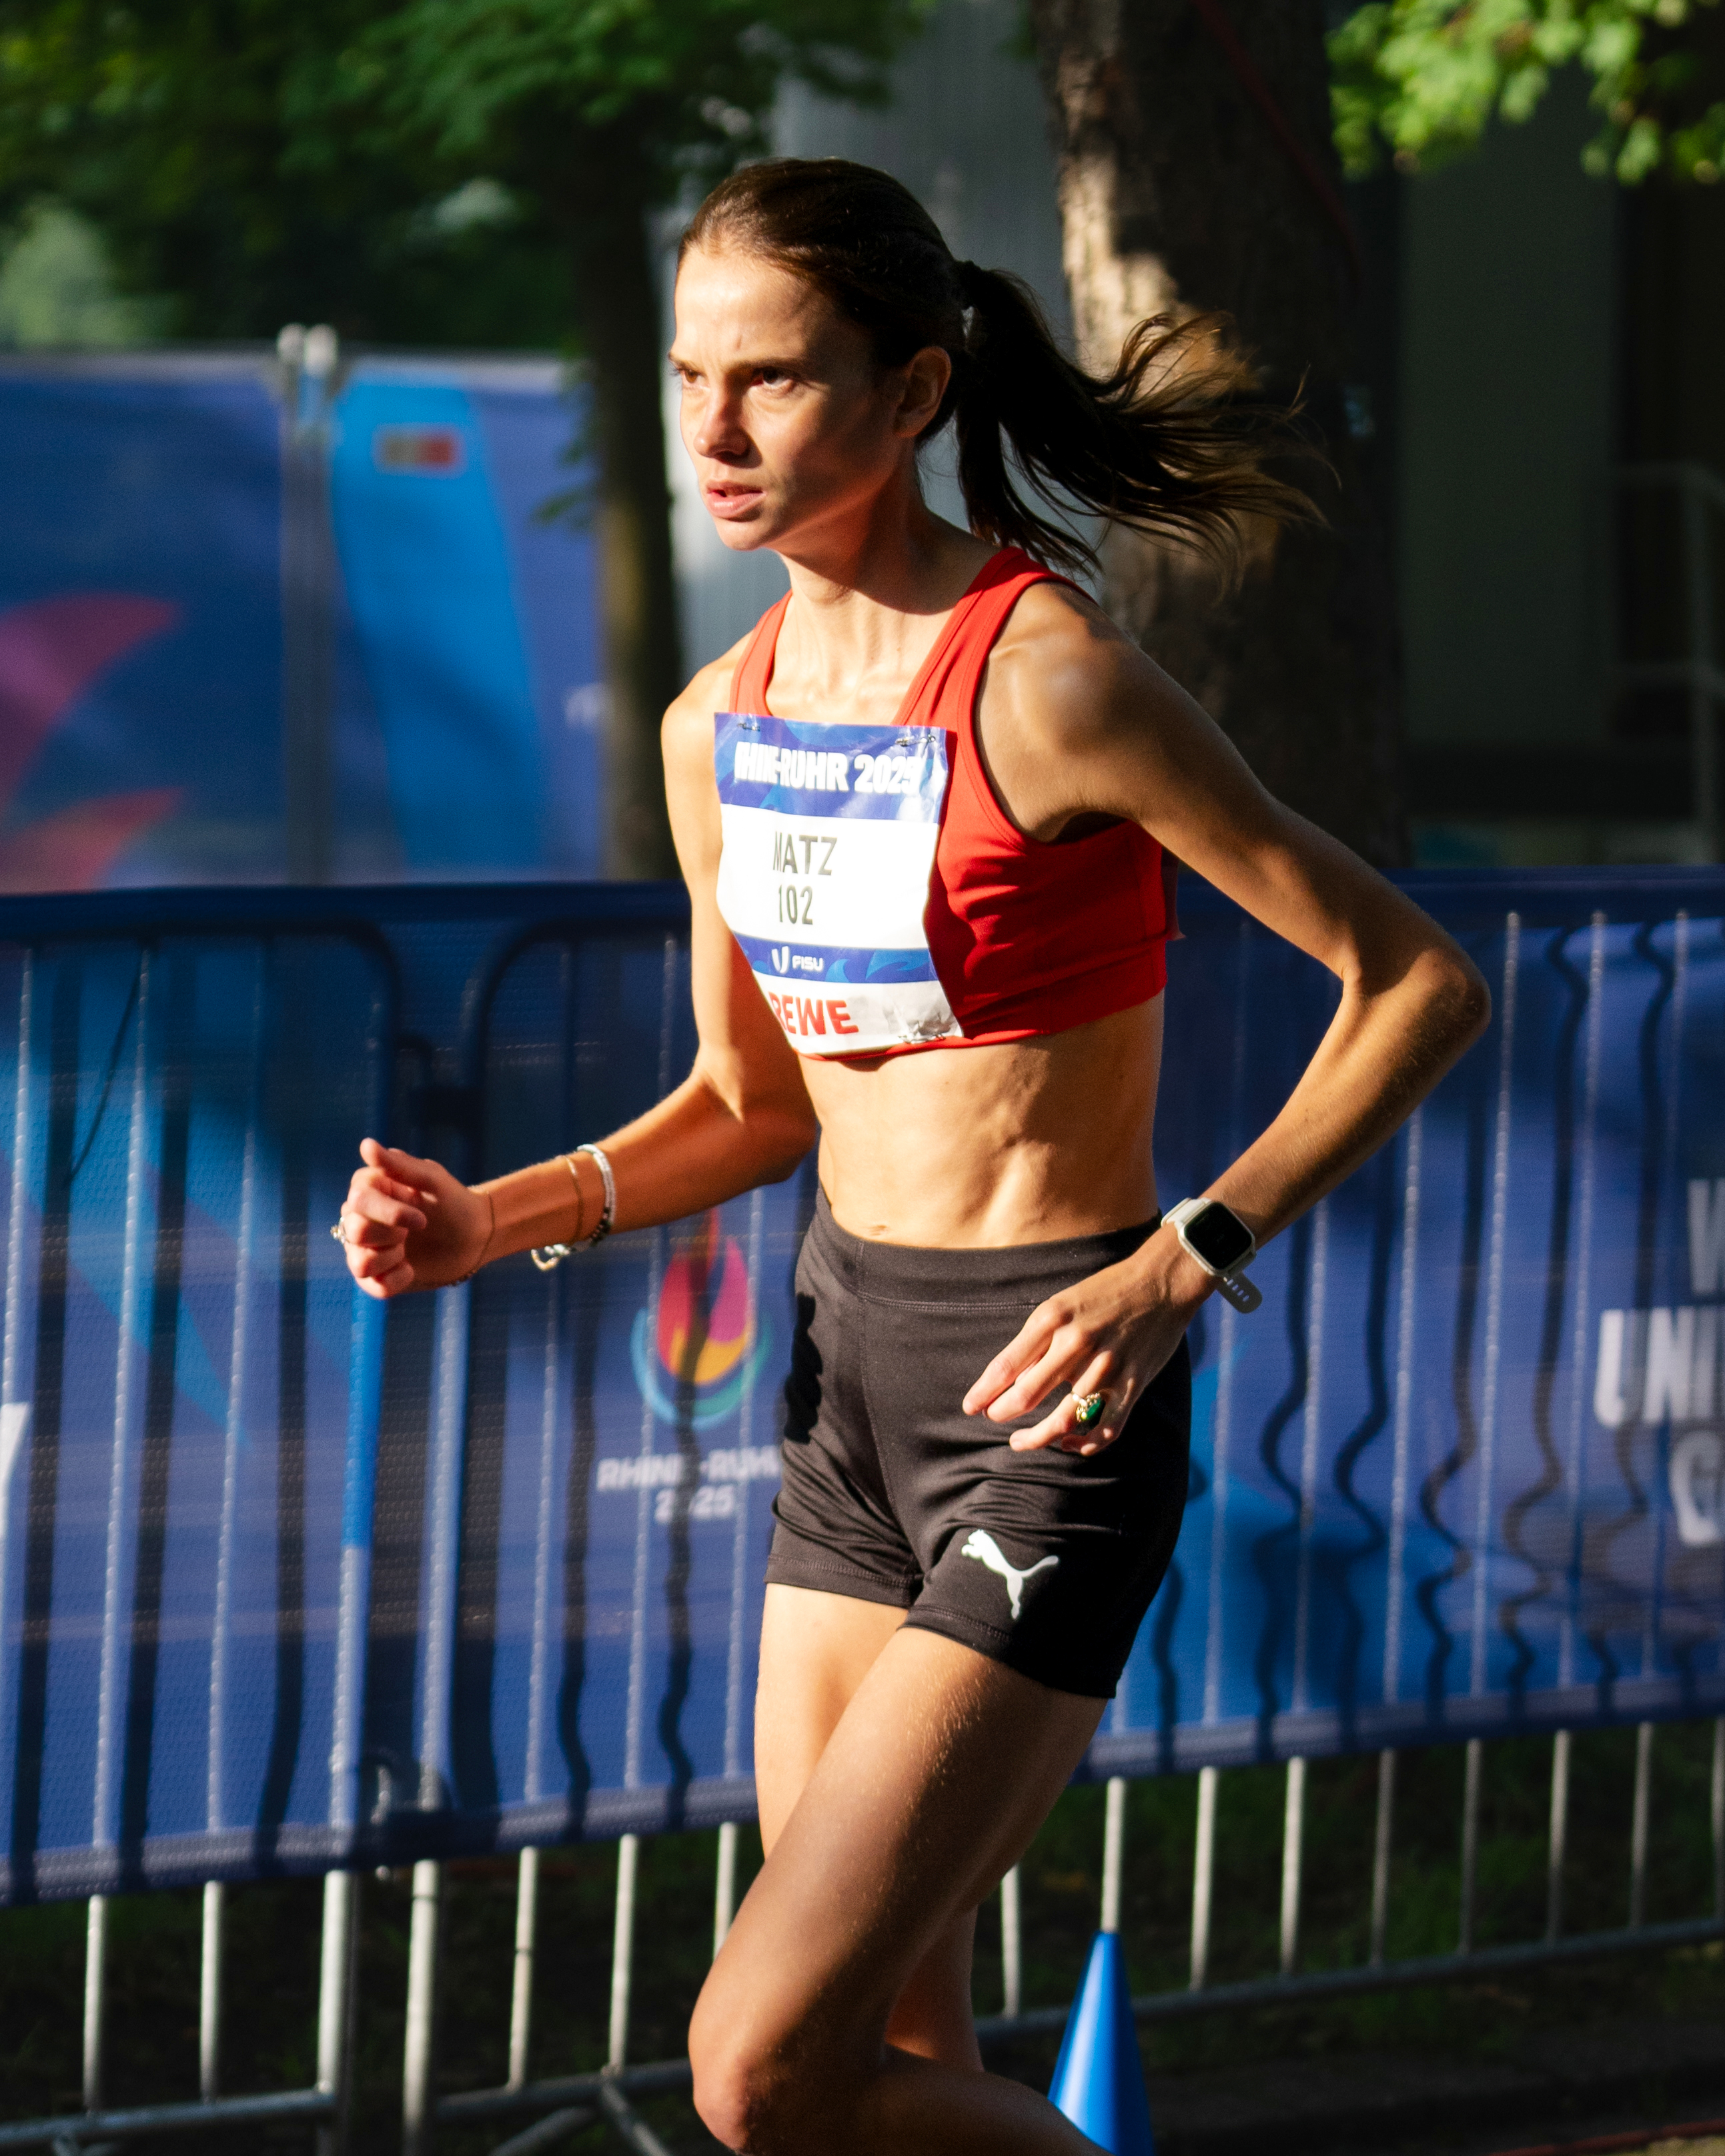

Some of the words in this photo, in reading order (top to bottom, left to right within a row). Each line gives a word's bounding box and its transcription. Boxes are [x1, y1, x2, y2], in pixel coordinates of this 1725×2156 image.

[854, 754, 924, 794] 2025
[778, 884, 813, 925] 102
[792, 955, 824, 972] FISU
[768, 991, 859, 1036] REWE
[1594, 1305, 1725, 1427] UNI
[654, 1484, 735, 1525] 225
